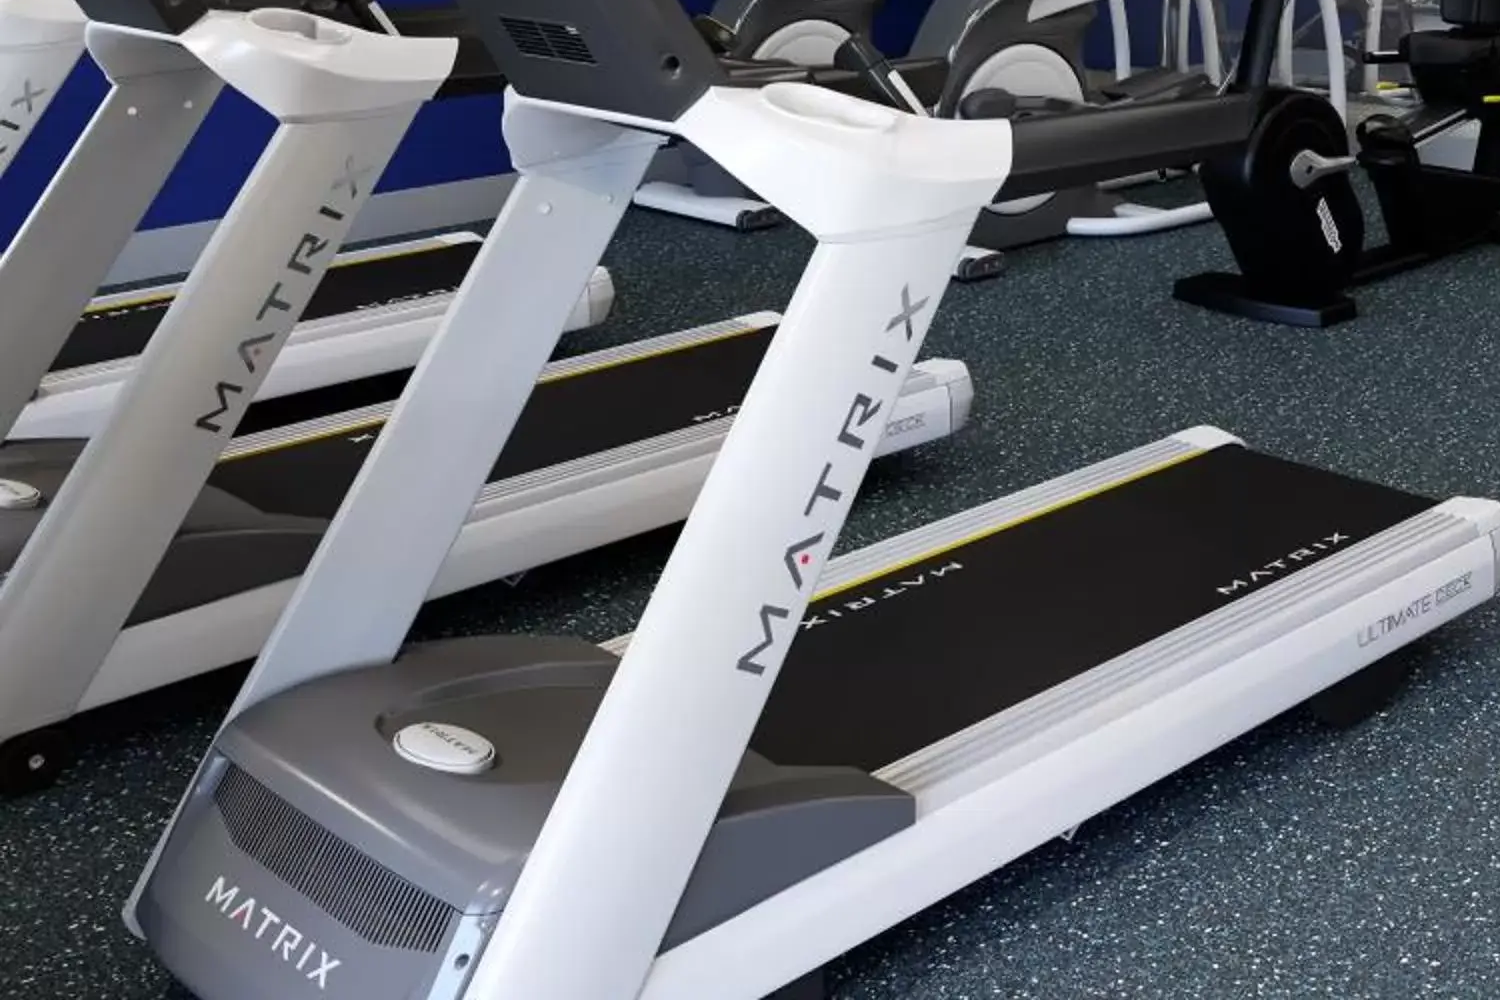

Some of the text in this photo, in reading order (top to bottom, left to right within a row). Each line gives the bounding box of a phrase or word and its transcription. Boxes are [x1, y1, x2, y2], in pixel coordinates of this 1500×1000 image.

[194, 153, 373, 434] MATRIX
[736, 282, 930, 677] MATRIX
[800, 560, 964, 630] MATRIX
[1216, 531, 1351, 595] MATRIX
[1357, 594, 1432, 647] ULTIMATE
[204, 875, 342, 990] MATRIX
